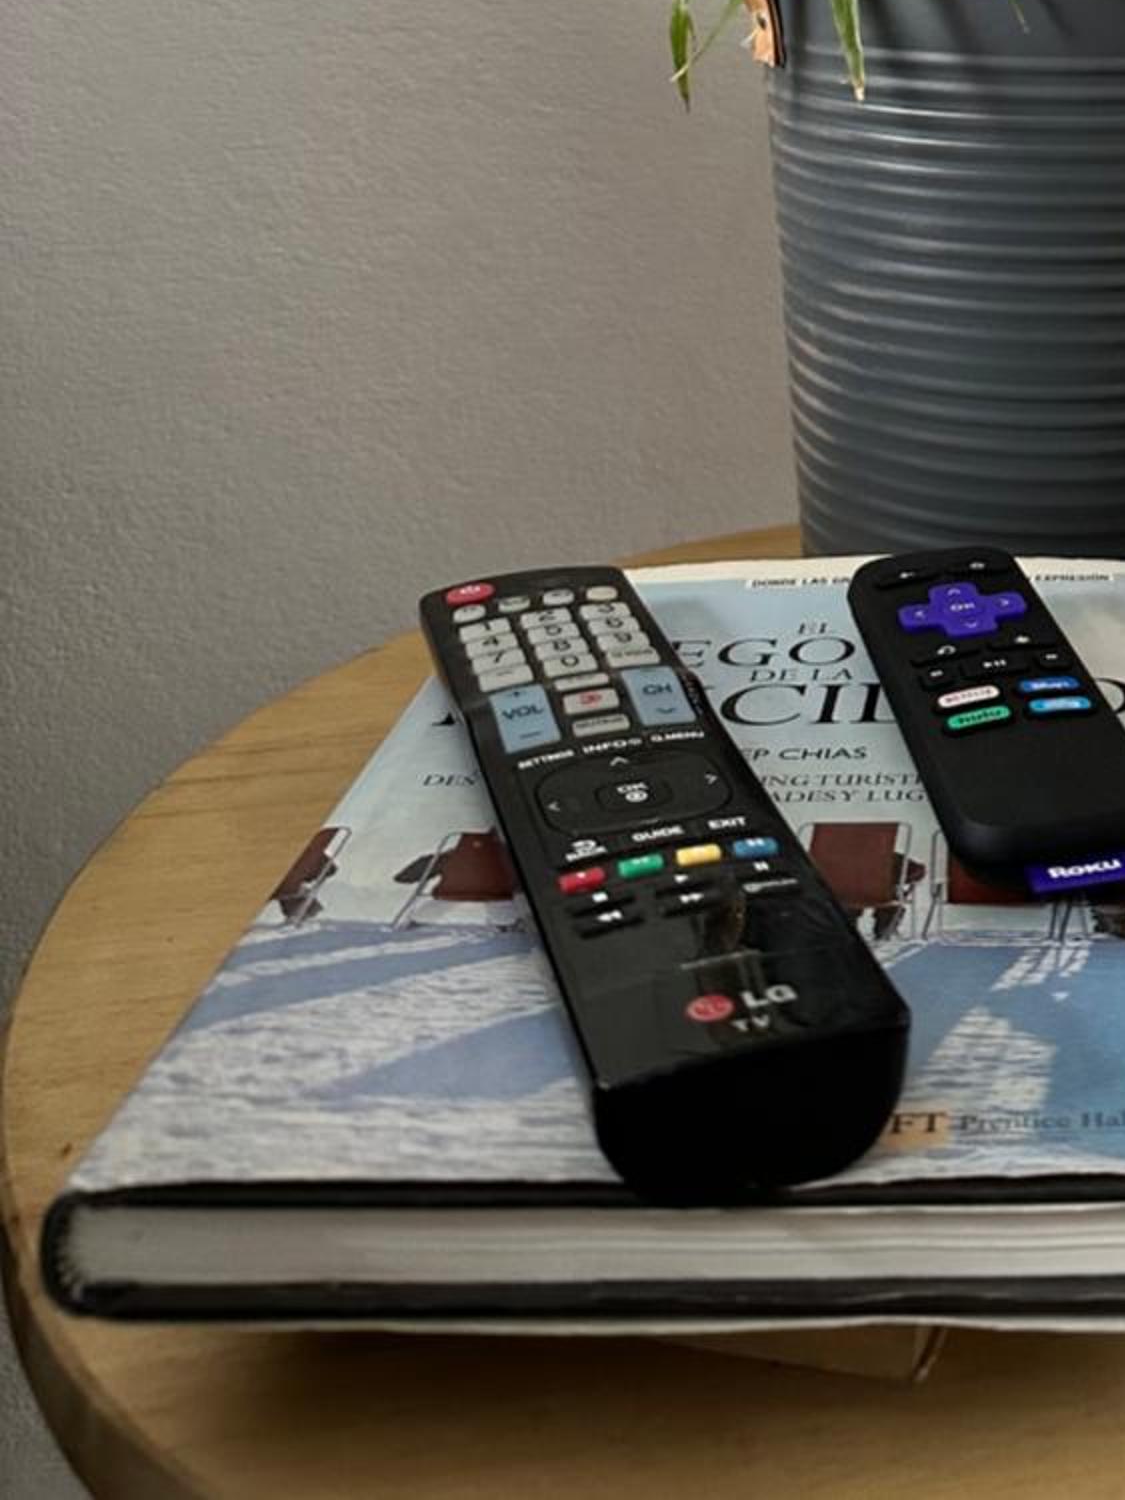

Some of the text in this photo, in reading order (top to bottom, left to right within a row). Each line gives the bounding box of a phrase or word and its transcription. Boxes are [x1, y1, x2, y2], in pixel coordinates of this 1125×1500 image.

[671, 637, 856, 668] EGO
[561, 655, 579, 667] 0
[750, 668, 853, 682] DE LA
[643, 683, 673, 696] CH
[502, 704, 543, 720] VOL
[517, 748, 576, 770] SETTINGS
[778, 746, 867, 760] CHIAS
[866, 790, 925, 801] LUG
[707, 816, 746, 830] EXIT
[632, 825, 685, 842] GUIDE
[741, 984, 798, 1009] LG
[731, 1015, 769, 1032] TV
[892, 1111, 947, 1134] FT
[959, 1113, 1071, 1132] Prentice
